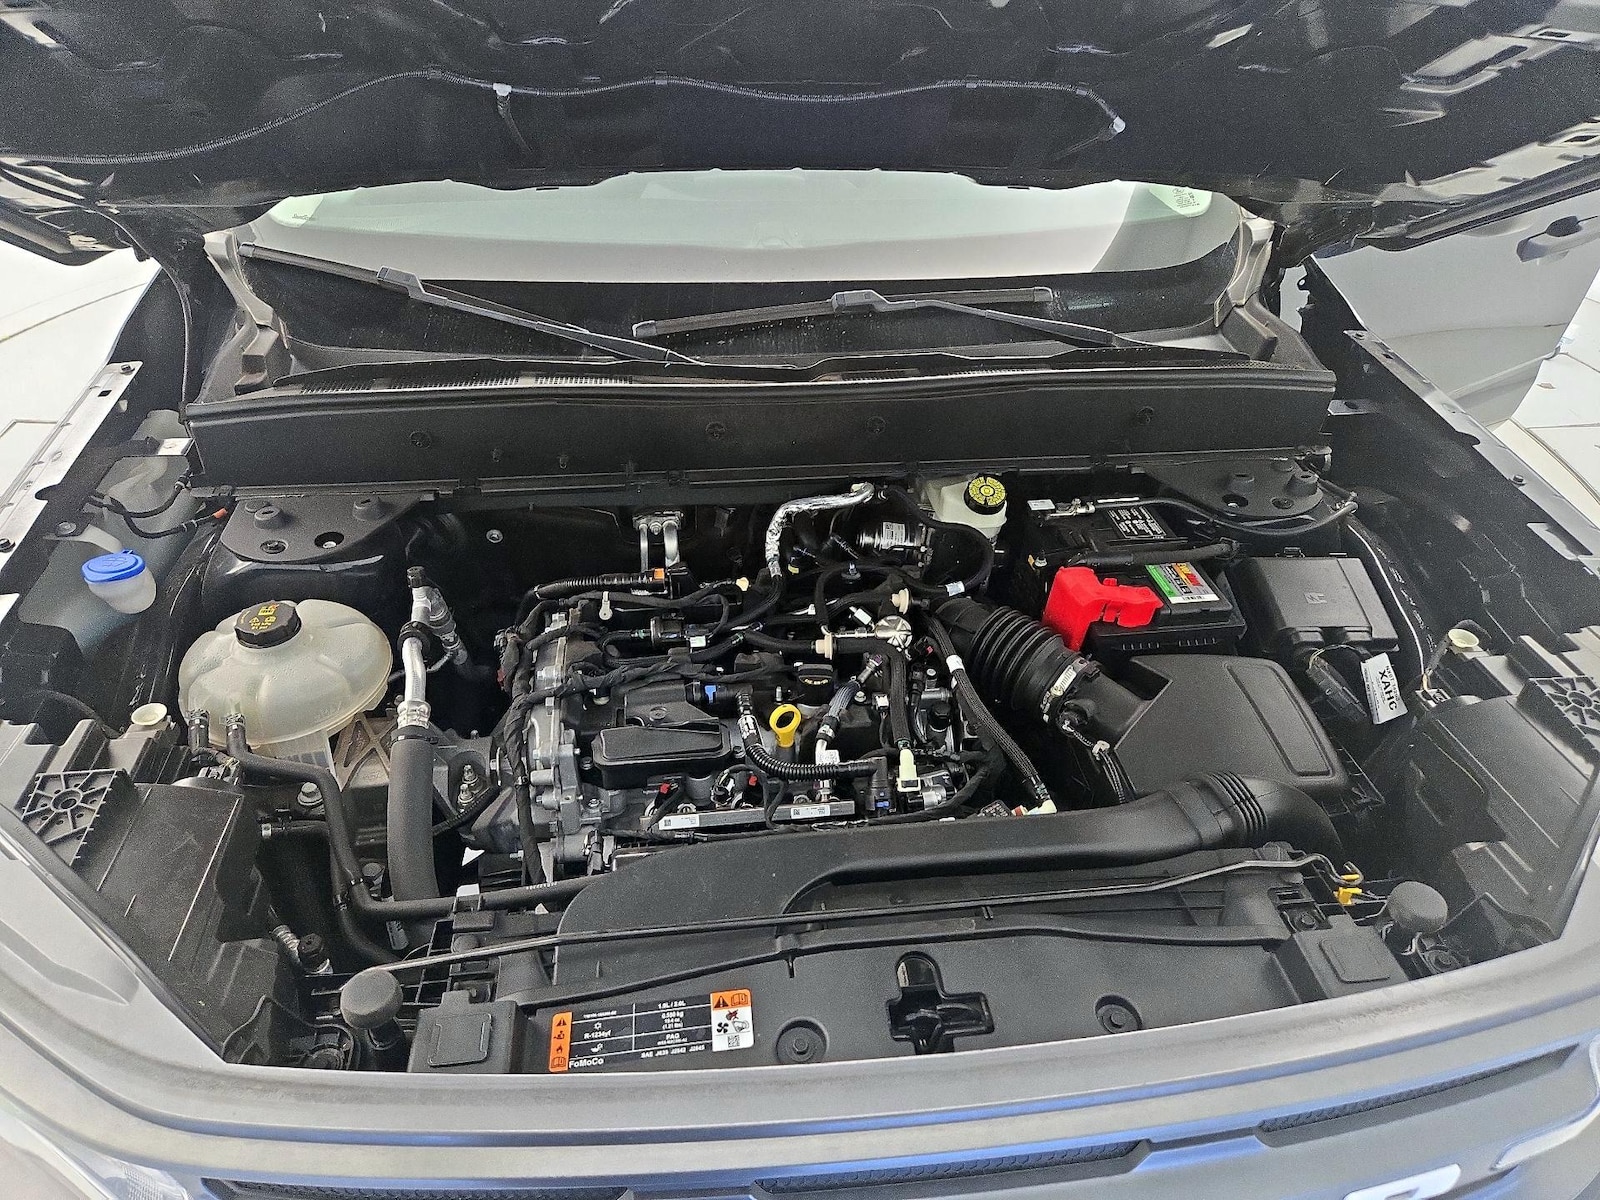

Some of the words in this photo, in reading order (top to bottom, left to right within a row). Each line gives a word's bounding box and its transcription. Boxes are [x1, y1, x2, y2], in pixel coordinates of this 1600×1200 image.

[1379, 669, 1398, 711] XAHC
[584, 1029, 611, 1039] R-1234yf
[569, 1057, 604, 1068] FoMoCo
